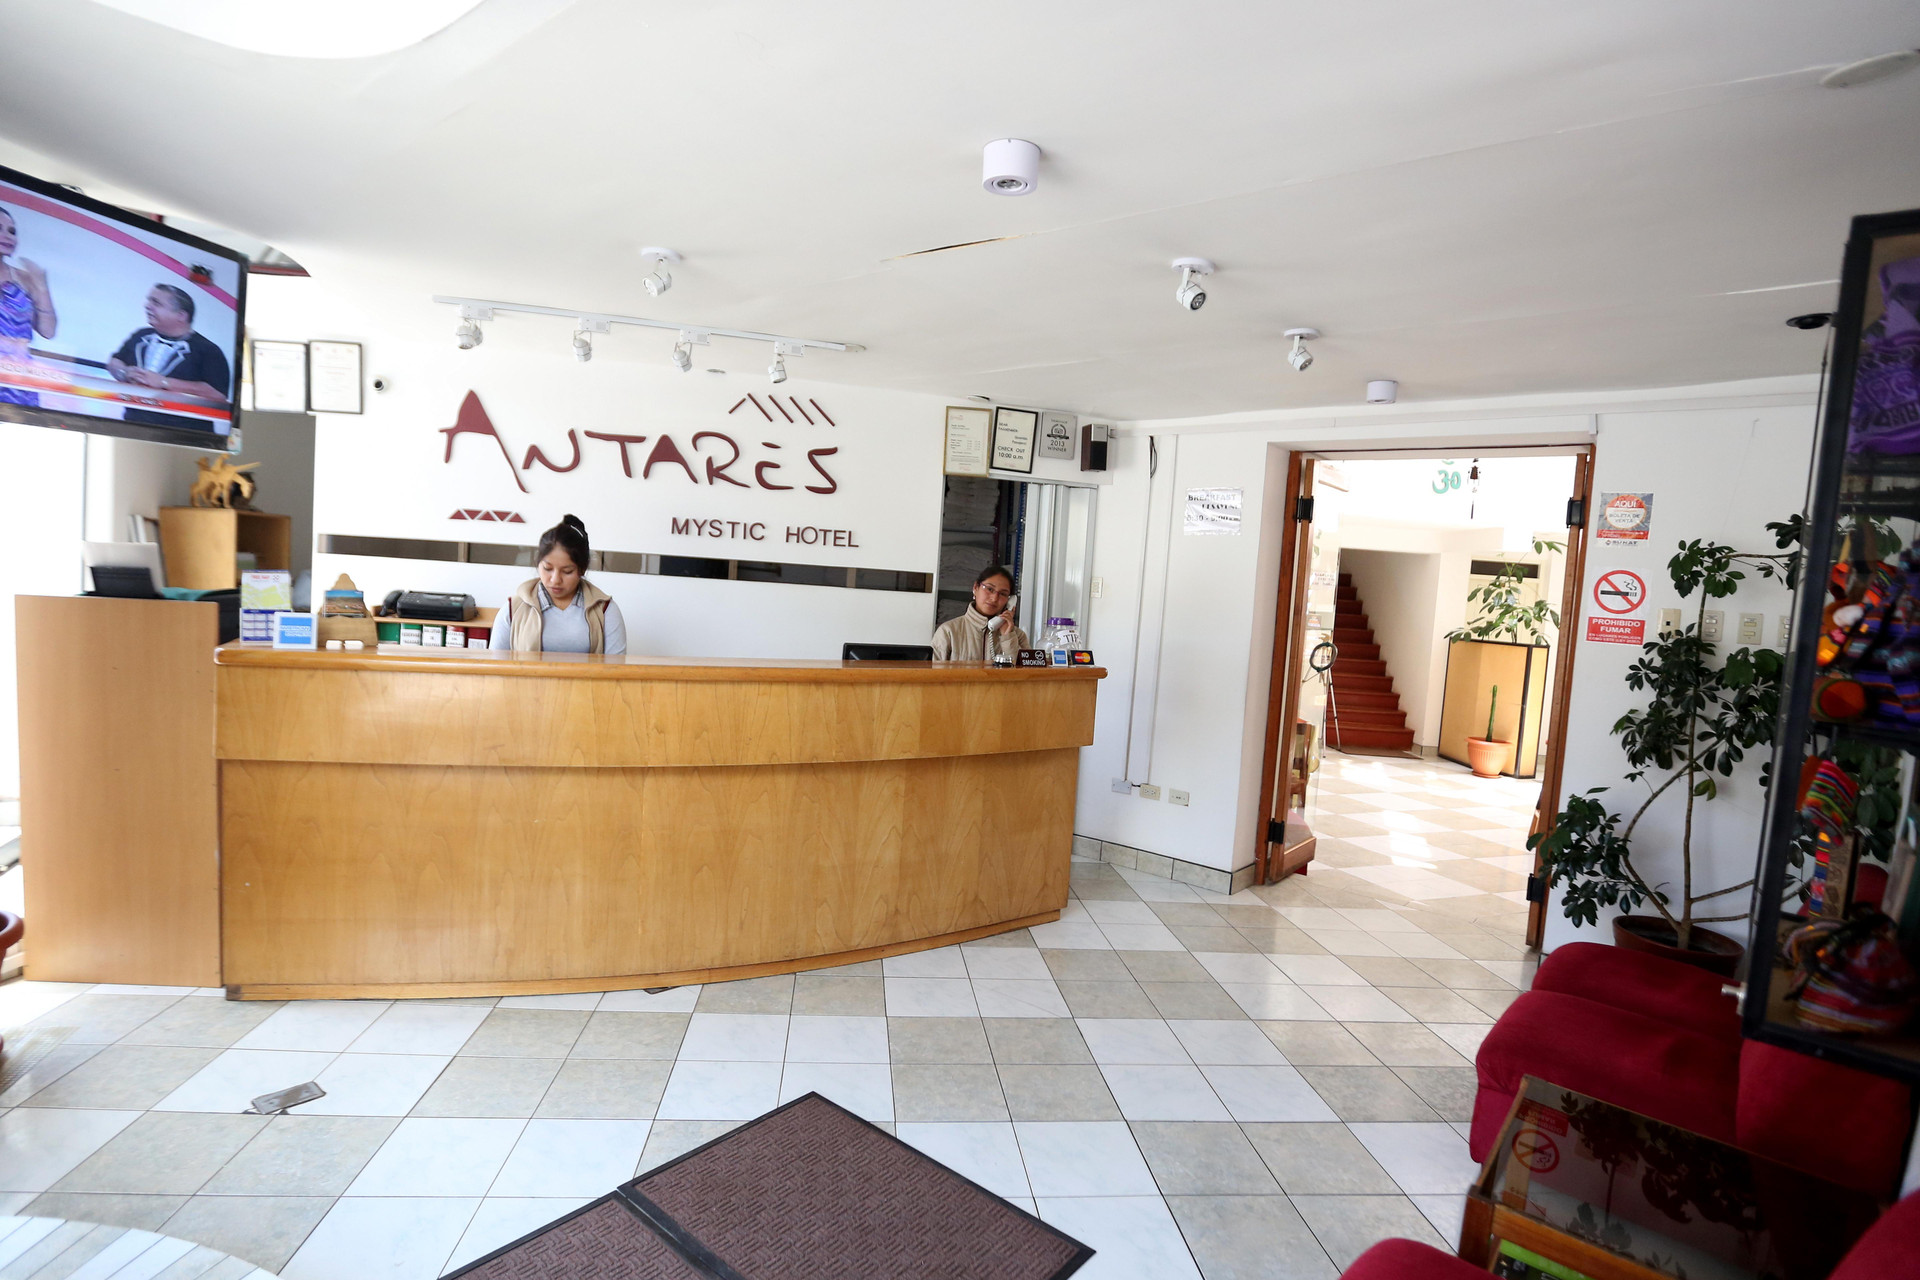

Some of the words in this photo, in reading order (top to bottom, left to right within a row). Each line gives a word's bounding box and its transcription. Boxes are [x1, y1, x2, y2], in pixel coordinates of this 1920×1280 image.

[1050, 439, 1065, 448] 2013
[997, 445, 1014, 453] CHECK
[671, 516, 766, 541] MYSTIC
[785, 525, 860, 548] HOTEL
[1592, 618, 1641, 628] PROHIBIDO
[1600, 625, 1632, 634] FUMAR
[1021, 651, 1030, 659] NO
[1022, 659, 1046, 667] SMOKING
